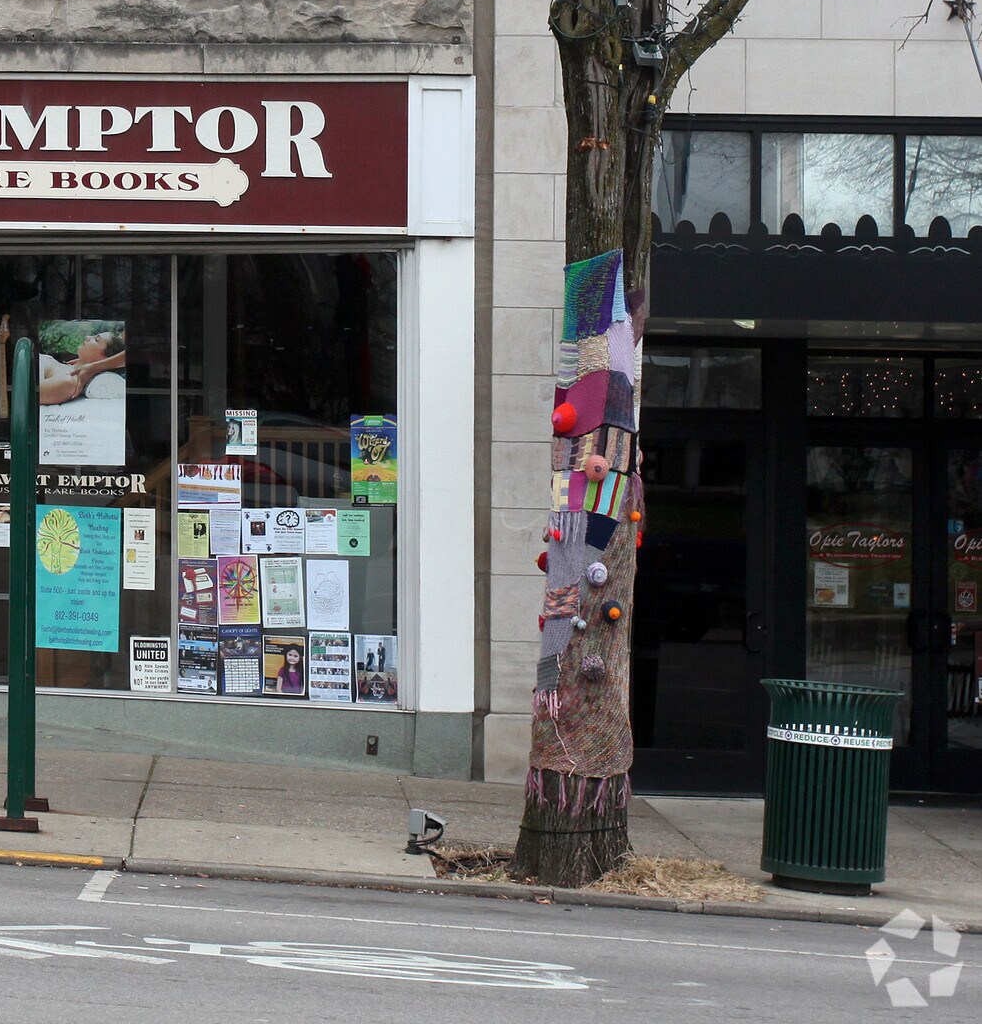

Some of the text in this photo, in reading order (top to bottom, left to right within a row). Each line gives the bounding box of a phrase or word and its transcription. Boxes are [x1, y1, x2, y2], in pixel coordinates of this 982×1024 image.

[50, 171, 200, 192] BOOKS
[58, 474, 147, 494] EMPTOR
[80, 488, 125, 496] BOOKS
[96, 512, 118, 520] Holistic
[88, 523, 109, 533] Healing
[809, 531, 904, 551] Opie Taylors
[54, 610, 99, 622] 812-391-0349
[136, 650, 166, 660] UNITED
[134, 664, 143, 672] NO
[134, 678, 143, 686] NOT
[793, 732, 829, 743] REDUCE
[843, 737, 871, 746] REUSE
